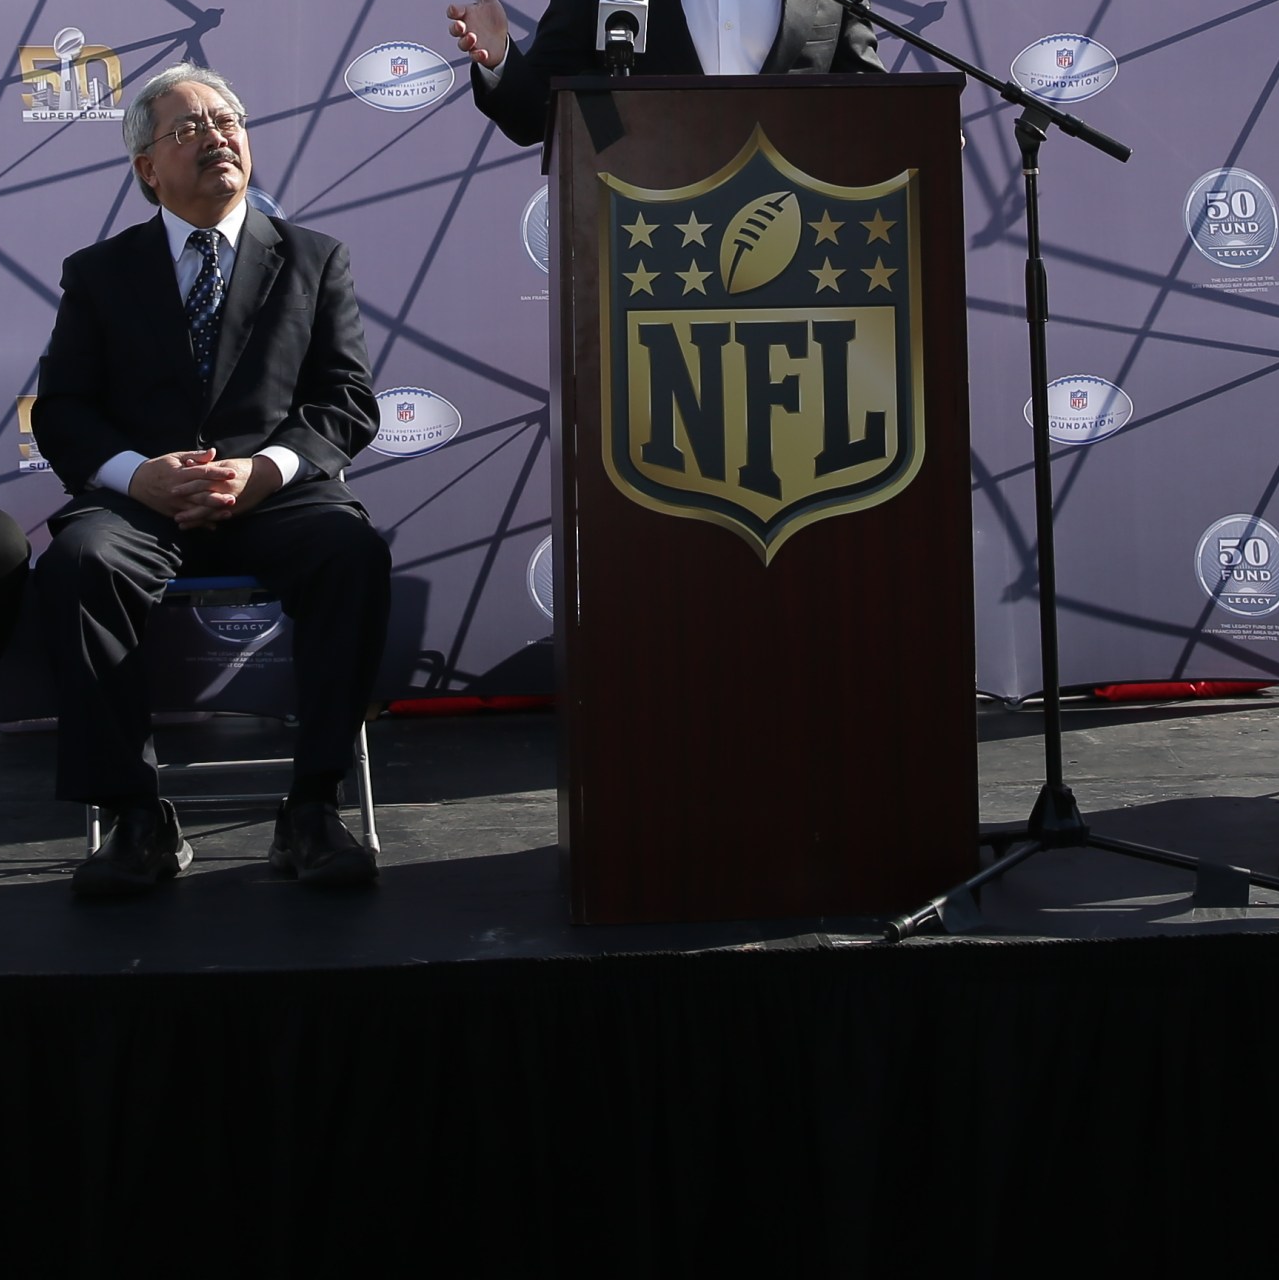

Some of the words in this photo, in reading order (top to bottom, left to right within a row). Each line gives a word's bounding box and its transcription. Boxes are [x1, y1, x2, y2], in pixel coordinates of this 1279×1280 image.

[1059, 57, 1072, 66] NFL
[393, 65, 407, 74] NFL
[17, 45, 123, 108] 50
[1030, 76, 1100, 88] FOUNDATION
[364, 85, 436, 96] FOUNDATION
[32, 112, 74, 120] SUPER
[80, 111, 115, 119] BOWL
[1206, 191, 1256, 219] 50
[1209, 222, 1259, 234] FUND
[1072, 399, 1087, 408] NFL
[400, 411, 413, 420] NFL
[638, 319, 887, 501] NFL
[1050, 417, 1114, 430] OUNDATION
[377, 430, 442, 442] OUNDATION
[29, 462, 52, 471] SUP
[1219, 538, 1269, 566] 50
[1221, 570, 1271, 581] FUND
